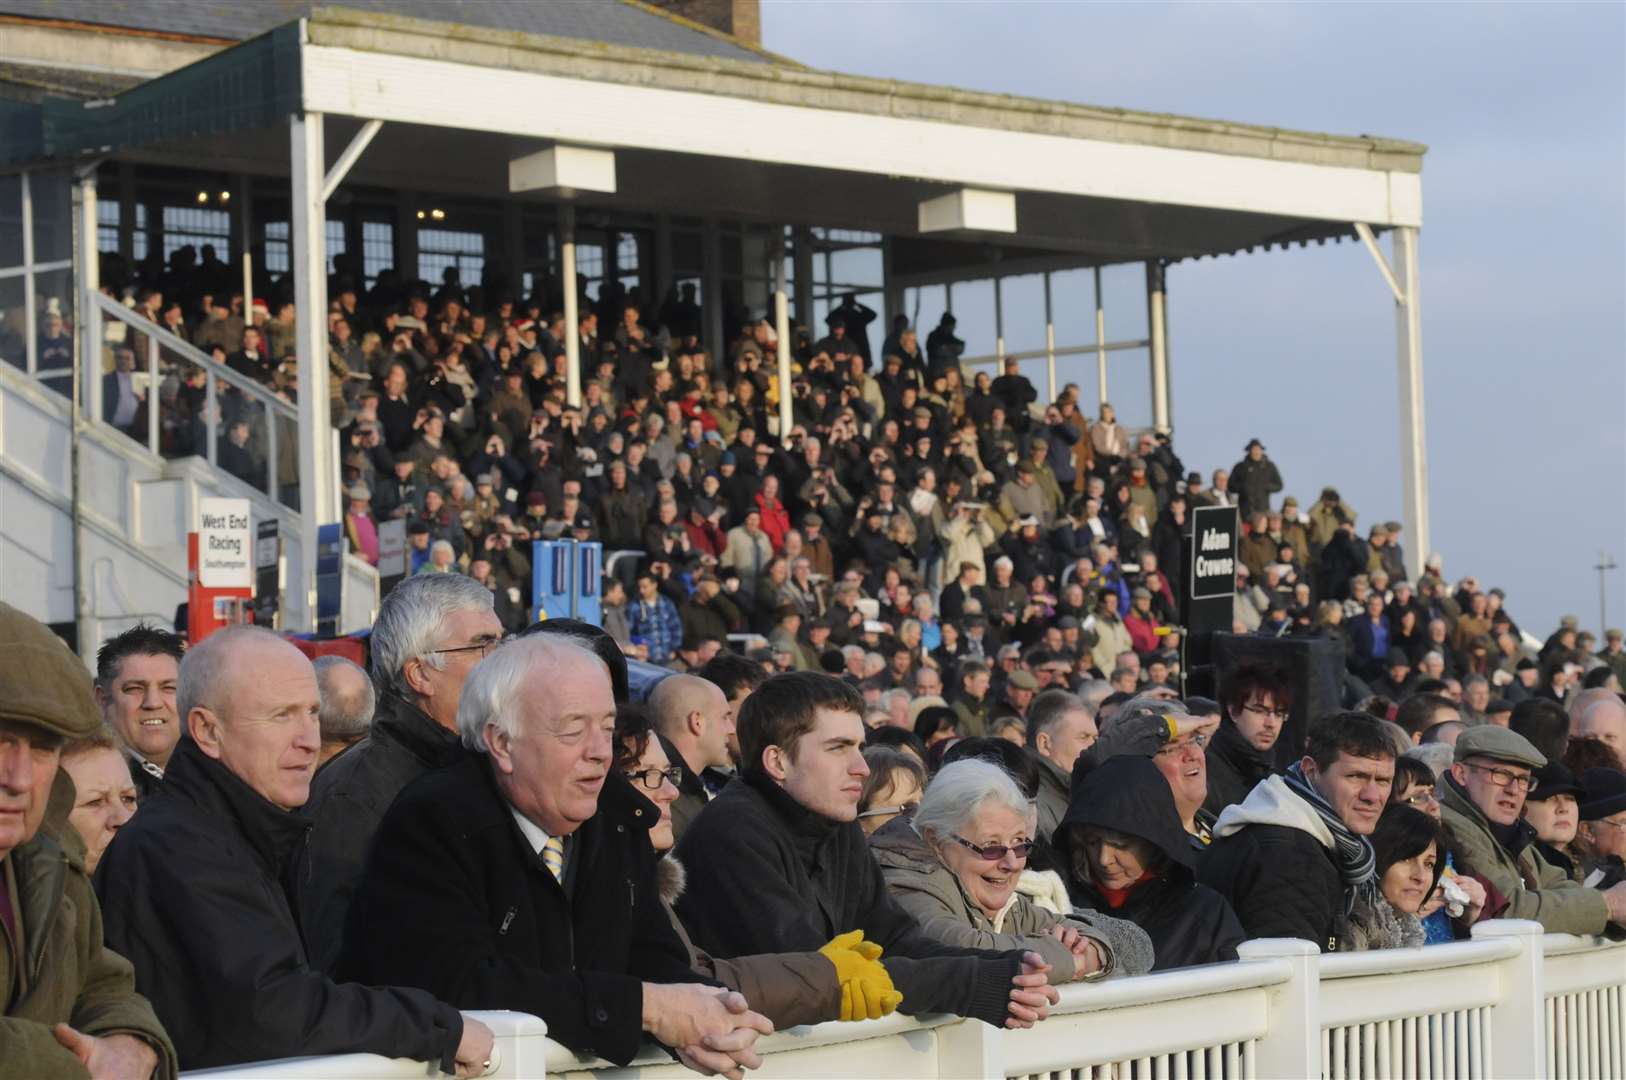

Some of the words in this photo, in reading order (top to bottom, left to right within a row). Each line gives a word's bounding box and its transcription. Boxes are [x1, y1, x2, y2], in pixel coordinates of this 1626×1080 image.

[202, 514, 225, 529] West
[229, 514, 248, 529] End
[209, 536, 241, 555] Racing
[1201, 528, 1230, 551] Adam
[1196, 555, 1234, 578] Crowne
